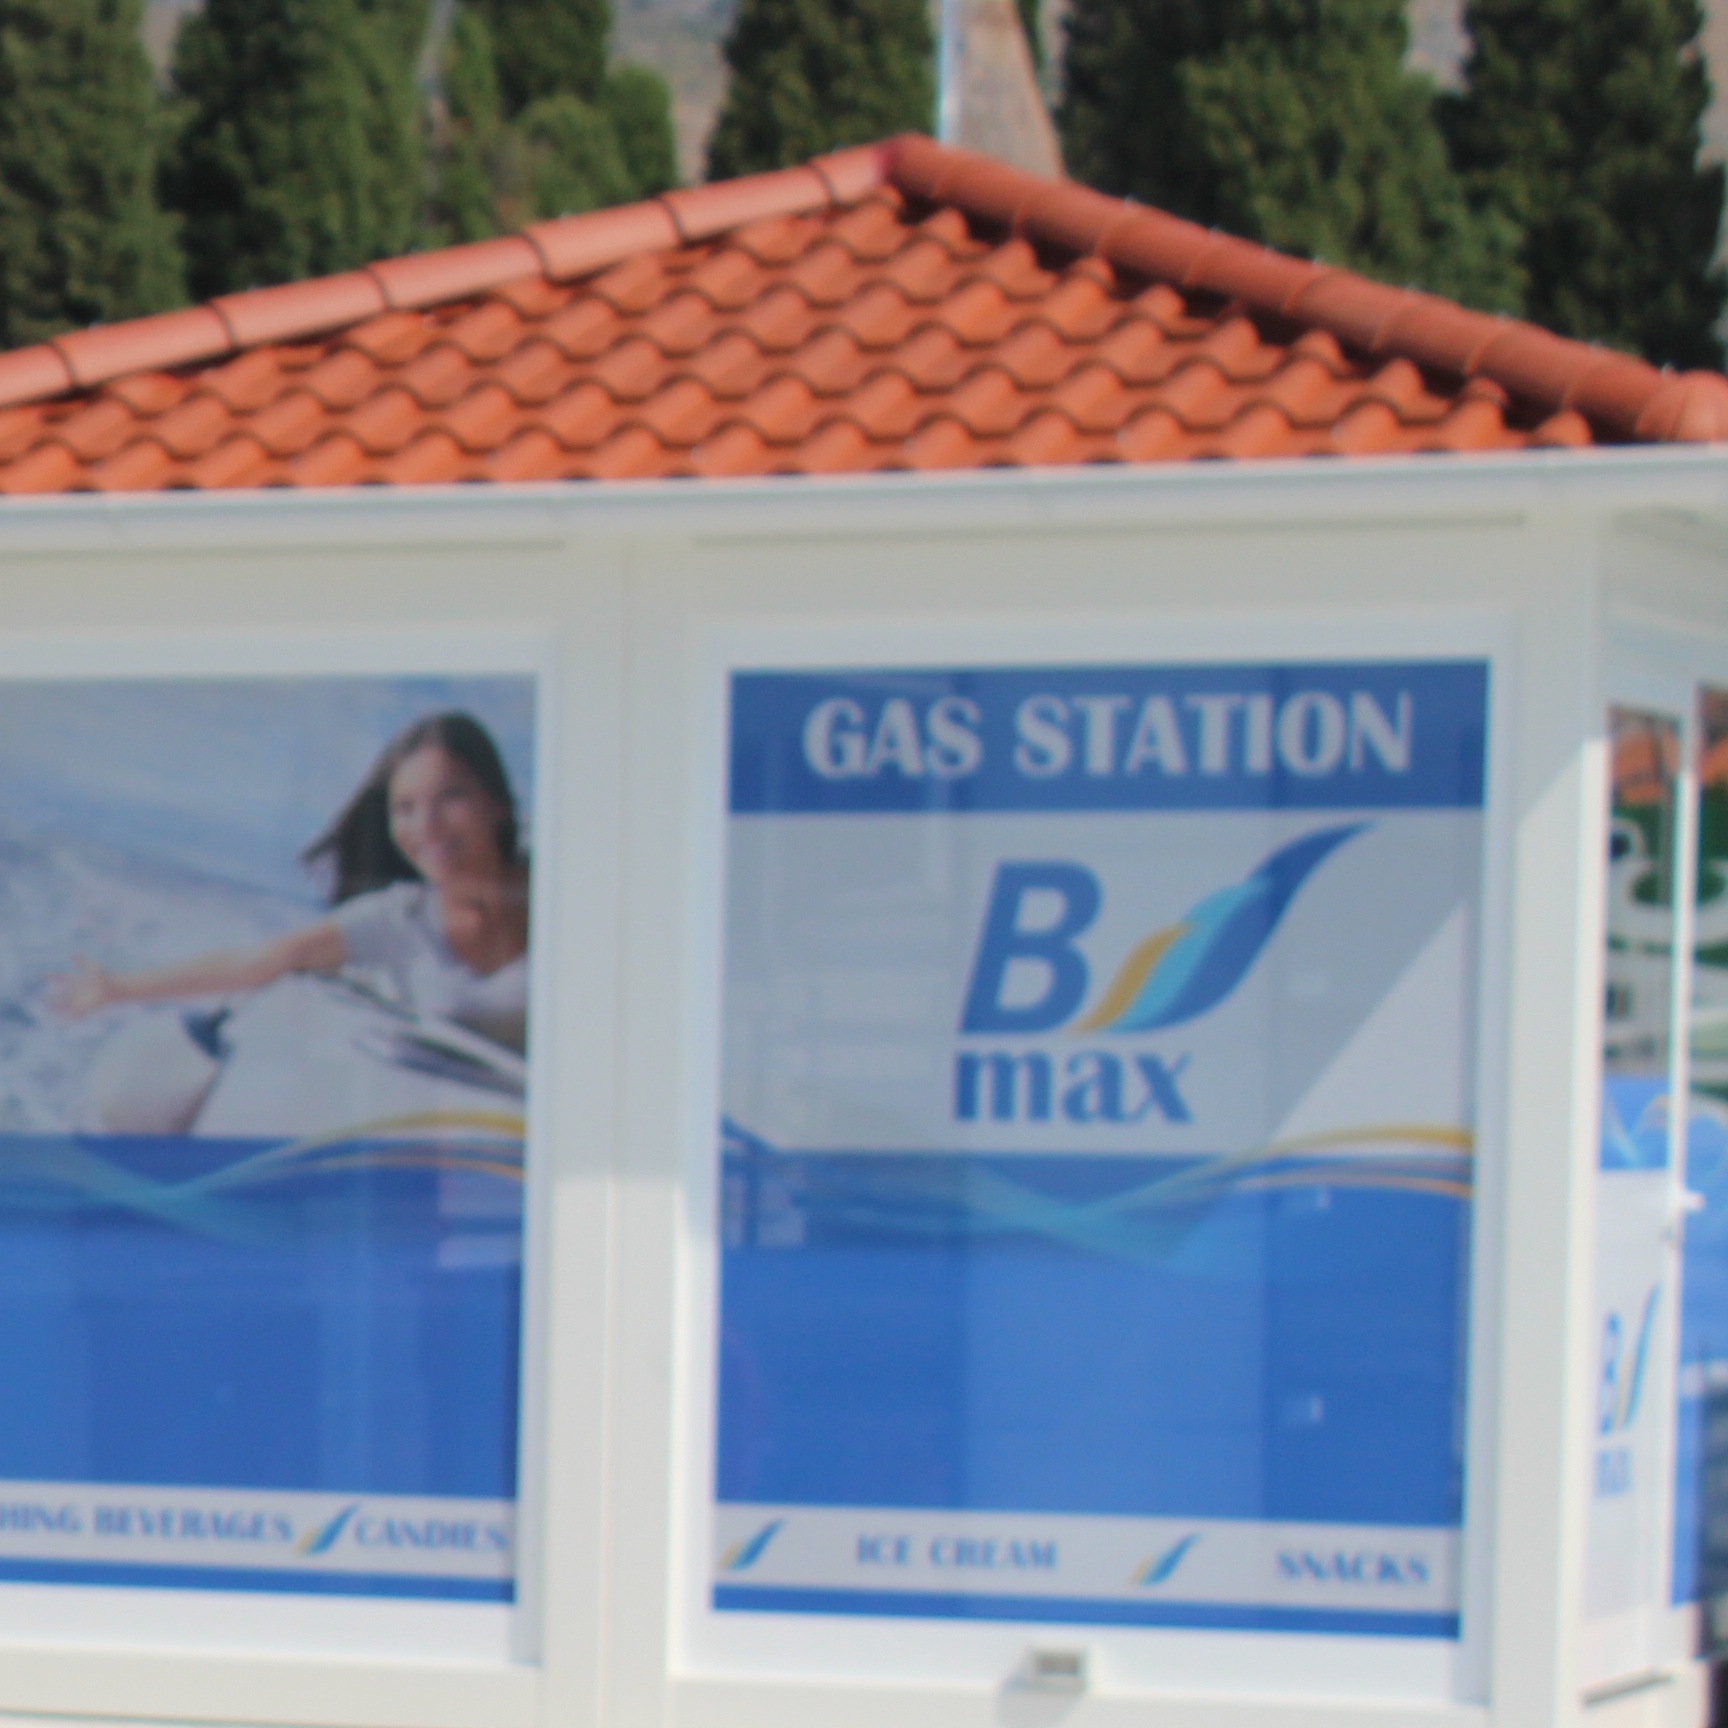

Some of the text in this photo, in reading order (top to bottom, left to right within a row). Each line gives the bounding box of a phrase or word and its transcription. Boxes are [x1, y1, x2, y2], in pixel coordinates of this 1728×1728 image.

[801, 690, 1412, 781] GAS STATION
[957, 857, 1104, 1037] B
[952, 1049, 1196, 1126] max
[94, 1505, 293, 1544] BEVERAGES
[355, 1515, 509, 1552] CANDIES
[856, 1535, 1058, 1571] ICE CREAM
[1275, 1550, 1430, 1586] SNACKS
